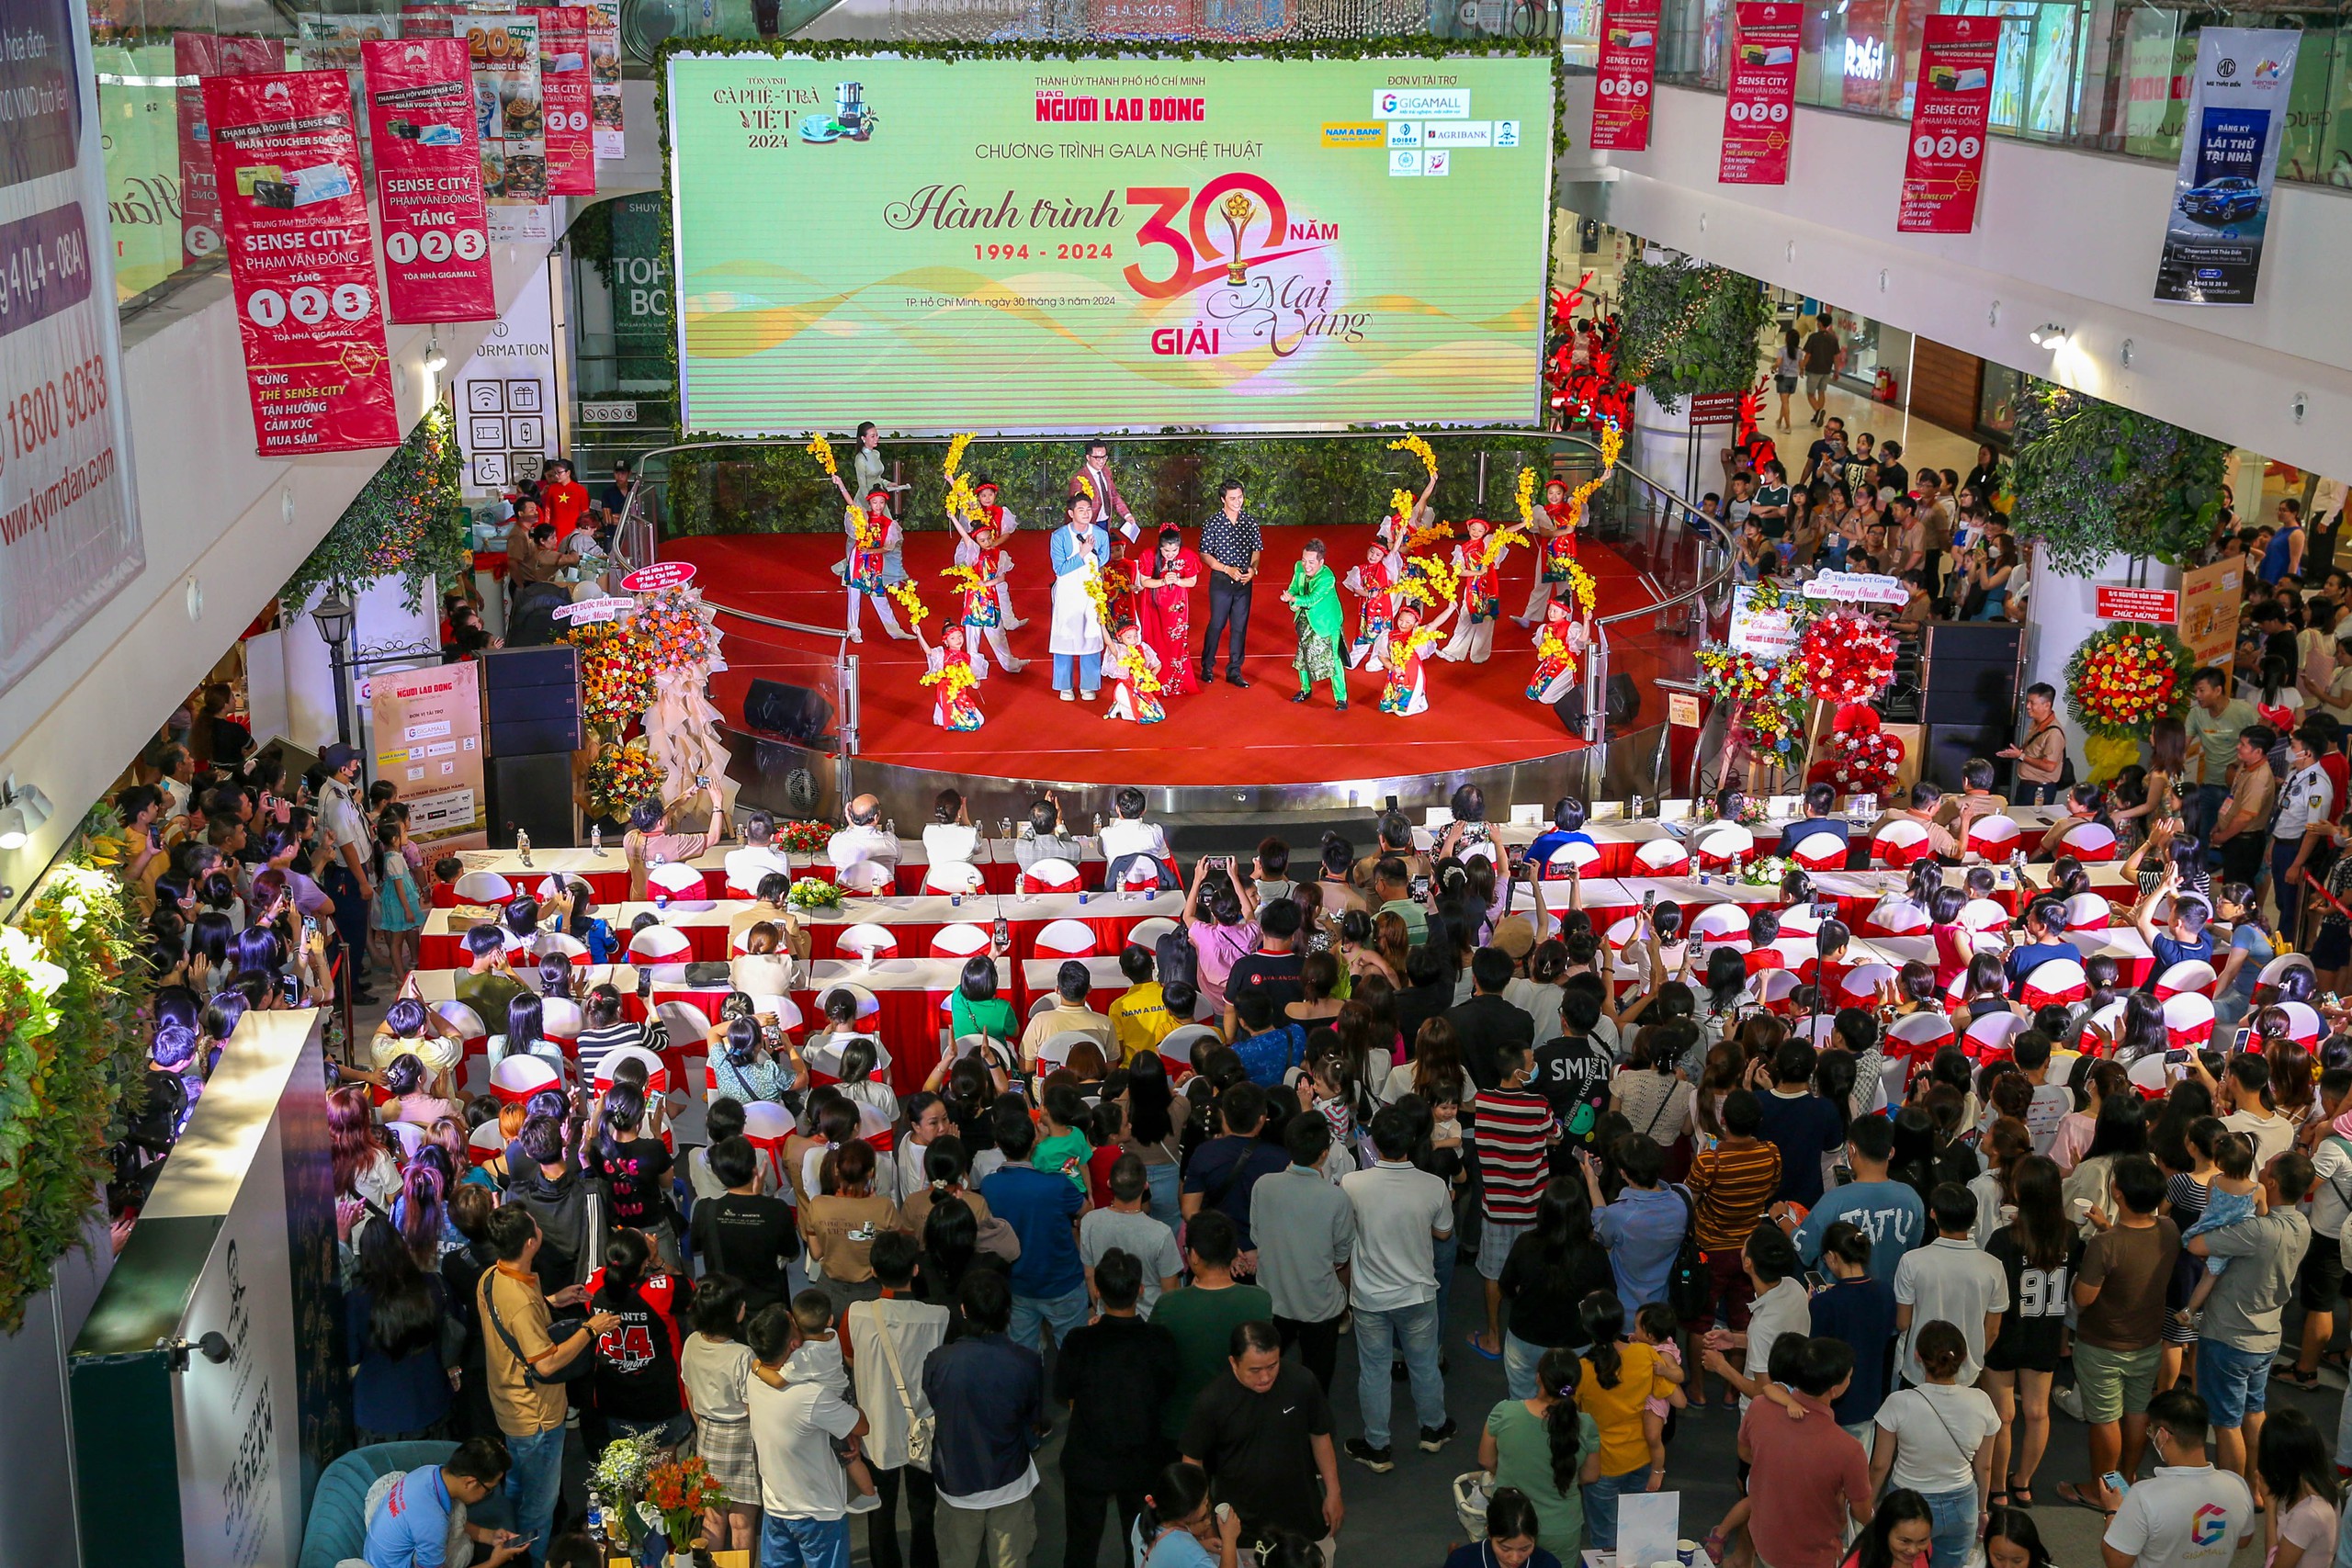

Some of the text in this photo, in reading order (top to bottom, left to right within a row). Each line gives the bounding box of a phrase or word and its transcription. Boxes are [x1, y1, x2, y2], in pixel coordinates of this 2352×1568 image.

[4, 26, 47, 61] hóa đơn
[1606, 56, 1648, 65] SENSE CITY
[1035, 74, 1205, 85] THÀNH ỦY THÀNH PHỐ HỒ CHÍ MINH
[1388, 74, 1457, 87] ĐƠN VỊ TÀI TRỢ
[1737, 76, 1788, 85] SENSE CITY
[562, 85, 582, 93] CITY
[1621, 84, 1627, 92] 2
[1637, 85, 1644, 93] 3
[14, 85, 40, 118] VND
[1399, 97, 1461, 108] GIGAMALL
[1035, 96, 1204, 123] NGƯỜI LAO ĐỘNG
[1756, 107, 1763, 118] 2
[1775, 108, 1782, 118] 3
[1924, 105, 1980, 115] SENSE CITY
[221, 117, 341, 138] THAM GIA HỘI SENSE CITY
[553, 116, 582, 126] 2 3
[1921, 117, 1980, 126] PHẠM VĂN ĐỒNG
[235, 137, 311, 151] NHẬN VOUCHER
[749, 135, 788, 148] 2024
[1921, 141, 1973, 153] 1 2 3
[2207, 137, 2256, 149] LÁI THỬ
[975, 140, 1263, 161] CHƯƠNG TRÌNH GALA NGHỆ THUẬT
[2206, 151, 2253, 164] TẠI NHÀ
[388, 176, 471, 193] SENSE CITY
[390, 193, 472, 208] PHẠM VĂN ĐỒNG
[628, 204, 661, 212] SHUYI
[884, 184, 1125, 231] Hành trình
[253, 219, 293, 229] TRUNG TÂM
[410, 209, 456, 226] TẦNG
[1290, 220, 1340, 240] NĂM
[244, 229, 352, 252] SENSE CITY
[396, 234, 477, 256] 1 2 3
[974, 243, 1114, 261] 1994 2024
[10, 253, 21, 297] 4
[23, 243, 46, 303] (L4
[56, 228, 86, 280] 08A)
[246, 249, 359, 270] PHẠM VĂN ĐỒNG
[289, 271, 321, 283] TẦNG
[403, 271, 477, 281] TÒA NHÀ GIGAMALL
[259, 291, 360, 319] 1 2 3
[905, 297, 1115, 309] TP. Hồ Chí Minh, ngày 30 tháng 3 năm 2024
[1150, 275, 1375, 357] GIẢI Mai Vàng
[273, 330, 355, 342] TÒA NHÀ GIGAMALL
[477, 344, 548, 357] ORMATION
[257, 374, 288, 386] CÙNG
[260, 385, 345, 400] THẺ SENSE CITY
[7, 355, 107, 459] 1800 9053
[263, 400, 327, 418] TẬN HƯỞNG
[265, 417, 313, 432] CẢM XÚC
[266, 431, 318, 446] MUA SẮM
[554, 607, 571, 617] CÔNG
[580, 602, 595, 612] DƯỢC
[2134, 612, 2160, 620] MỪNG
[419, 686, 432, 694] LAO
[417, 725, 447, 734] GIGAMALL
[1121, 1009, 1142, 1018] NAM
[1839, 1207, 1913, 1245] TATU
[2020, 1267, 2067, 1317] 91
[222, 1460, 237, 1507] THE
[240, 1375, 269, 1465] JOURNEY
[237, 1403, 273, 1519] DREAM
[2182, 1548, 2227, 1560] GIGAMALL
